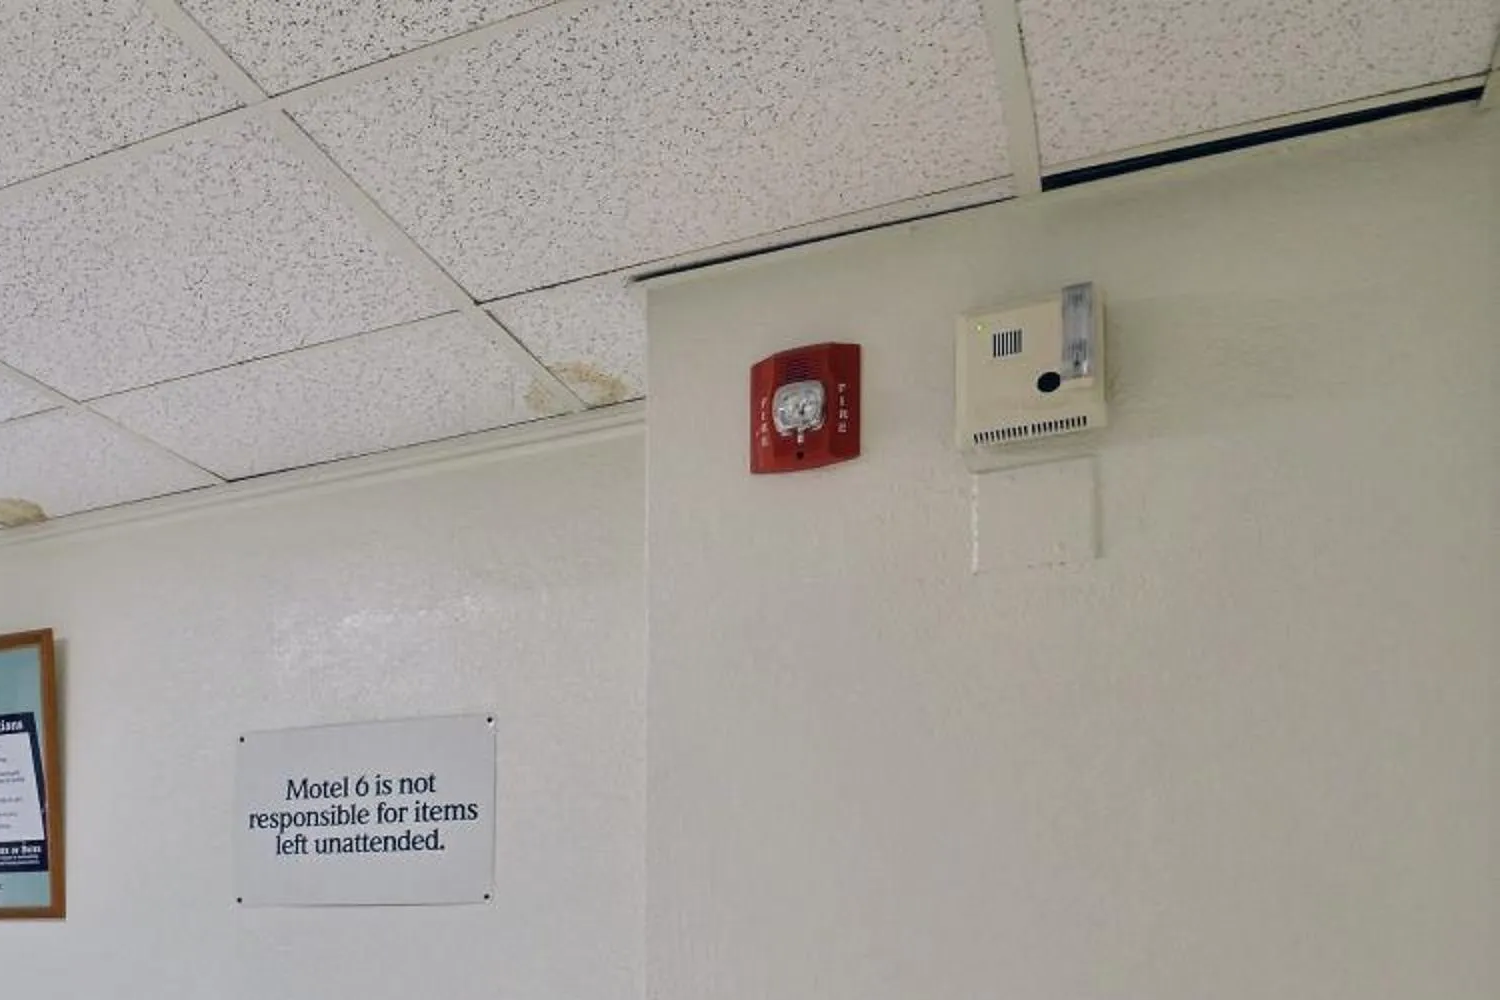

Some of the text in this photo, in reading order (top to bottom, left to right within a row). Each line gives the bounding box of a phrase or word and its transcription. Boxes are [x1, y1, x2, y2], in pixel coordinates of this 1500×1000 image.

[285, 773, 437, 801] Motel 6 is not
[249, 800, 479, 834] responsible for items
[275, 828, 446, 856] left unattended.
